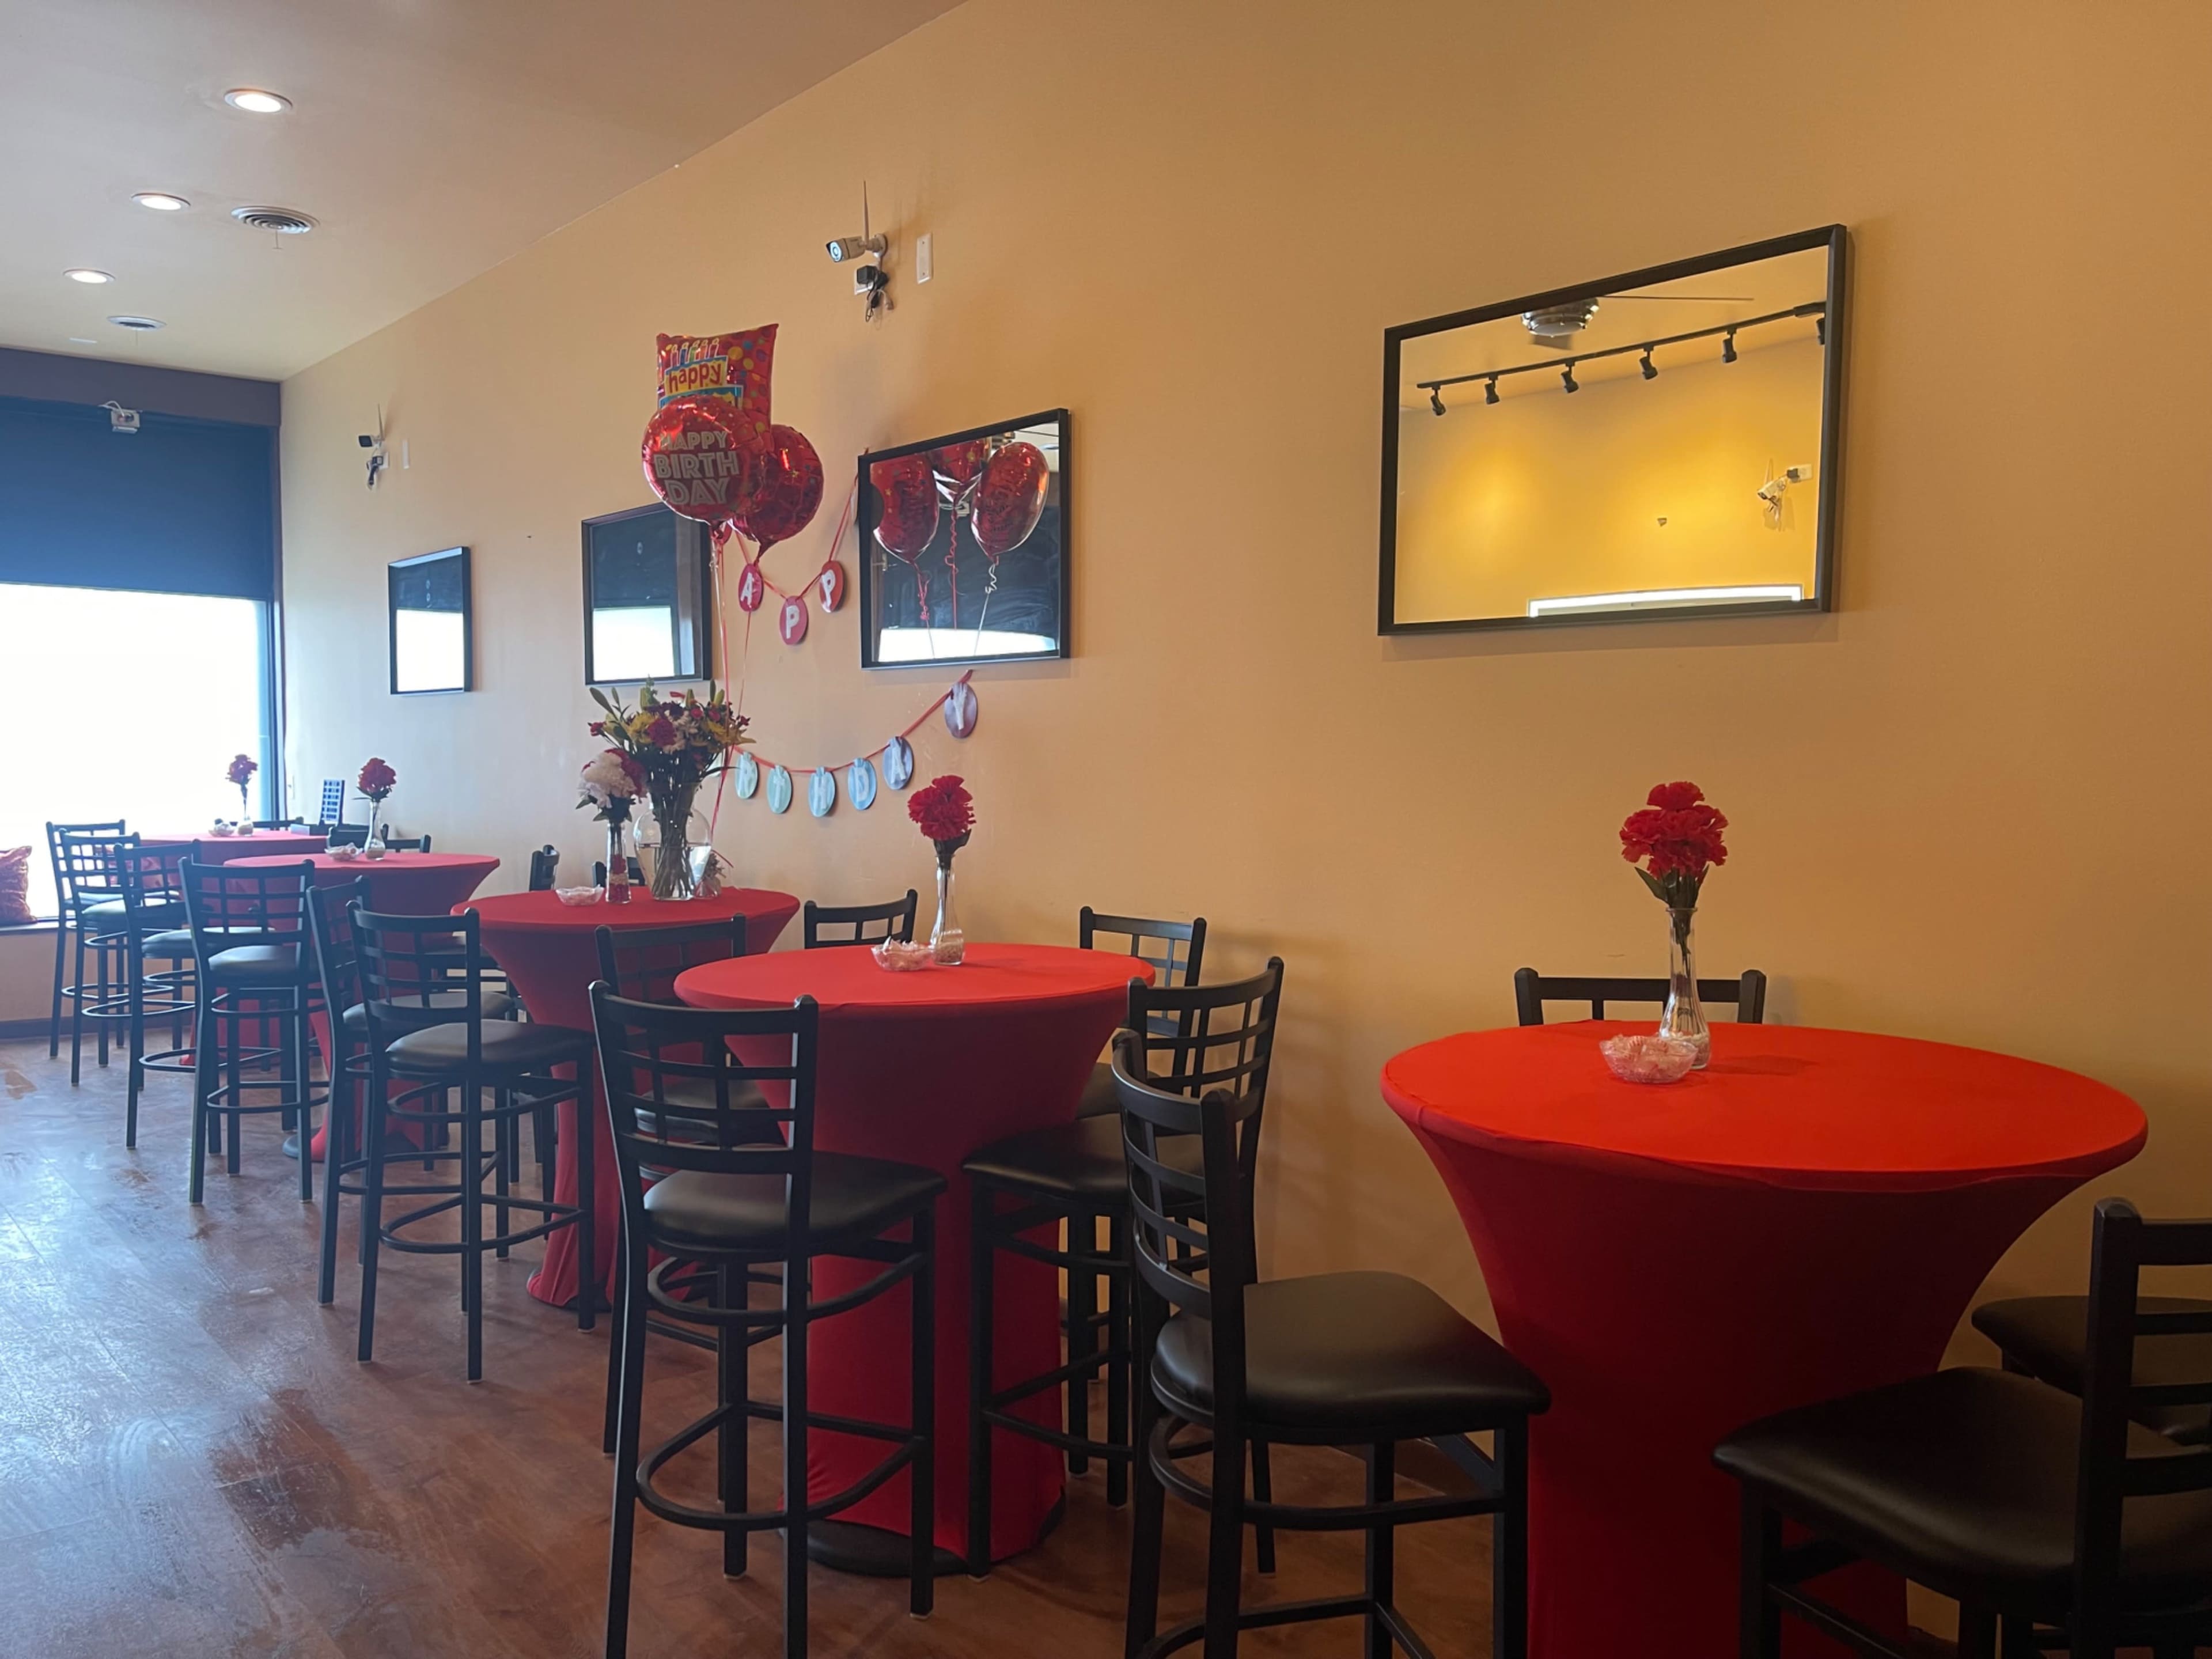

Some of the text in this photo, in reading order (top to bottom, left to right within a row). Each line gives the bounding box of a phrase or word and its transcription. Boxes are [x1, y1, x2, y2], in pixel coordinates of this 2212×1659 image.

[668, 363, 721, 393] happy
[661, 431, 728, 451] HAPPY
[654, 452, 740, 479] BIRTH
[665, 478, 729, 505] DAY
